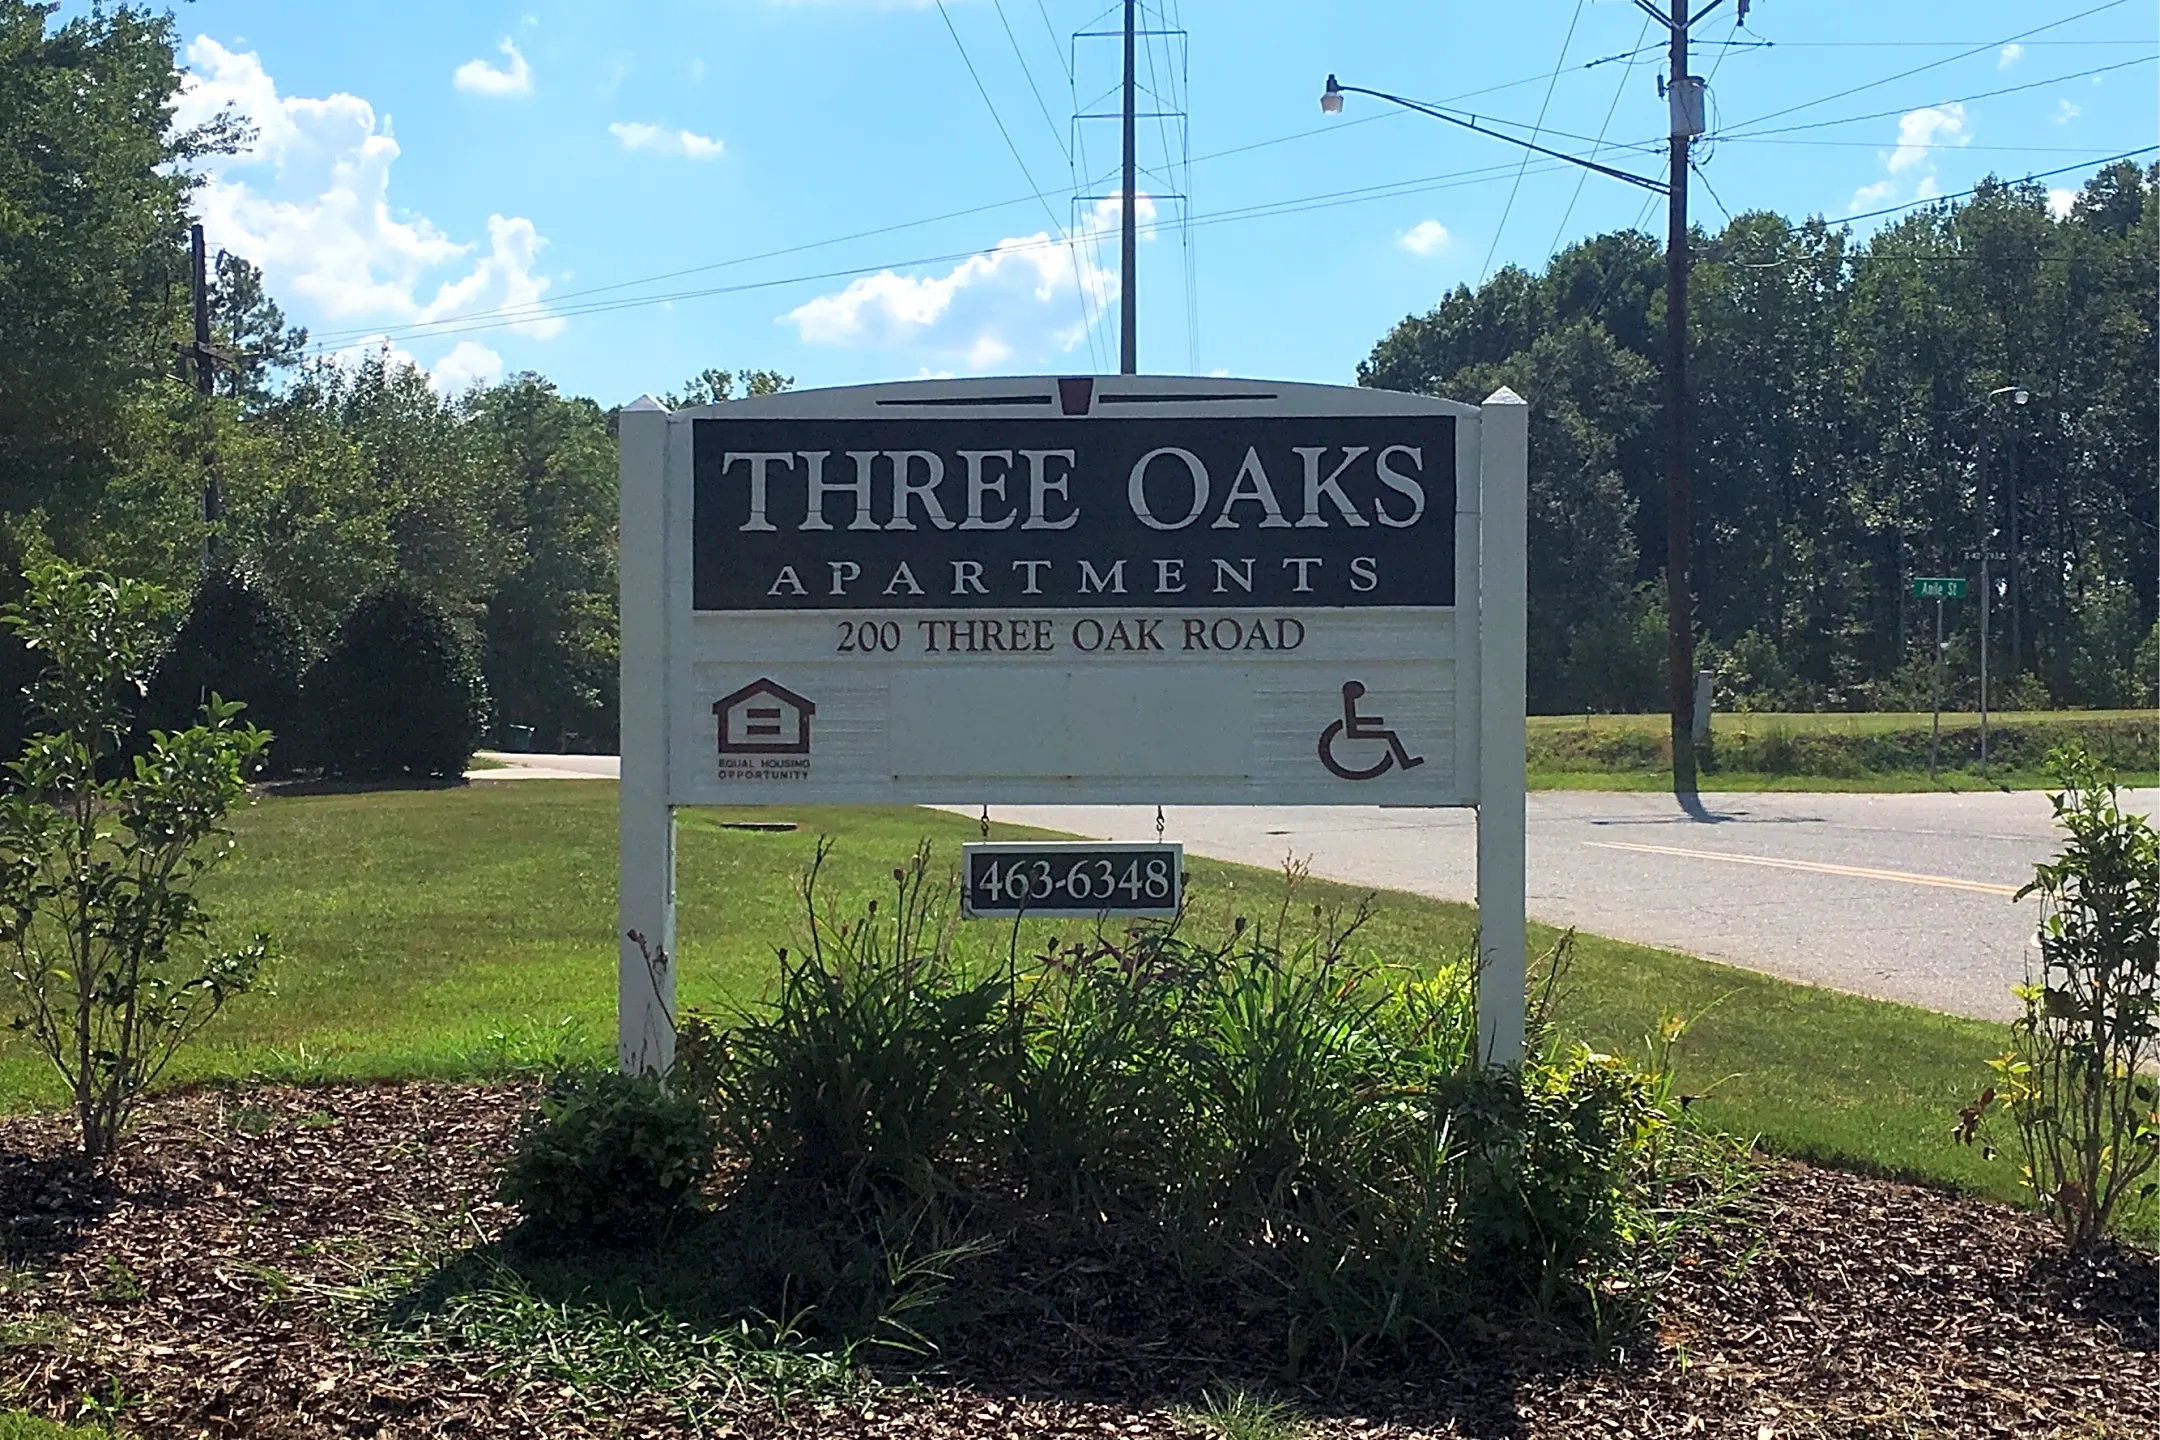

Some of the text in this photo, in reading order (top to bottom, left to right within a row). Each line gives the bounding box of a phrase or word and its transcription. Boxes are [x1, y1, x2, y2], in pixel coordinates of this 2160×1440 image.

[721, 444, 1427, 532] THREE OAKS
[766, 556, 1379, 596] APARTMENTS
[1947, 582, 1957, 596] St
[836, 617, 1306, 652] 200 THREE OAK ROAD
[718, 759, 811, 768] EQUAL HOUSING
[718, 770, 810, 780] OPPORTUNITY
[978, 858, 1170, 902] 463-6348
